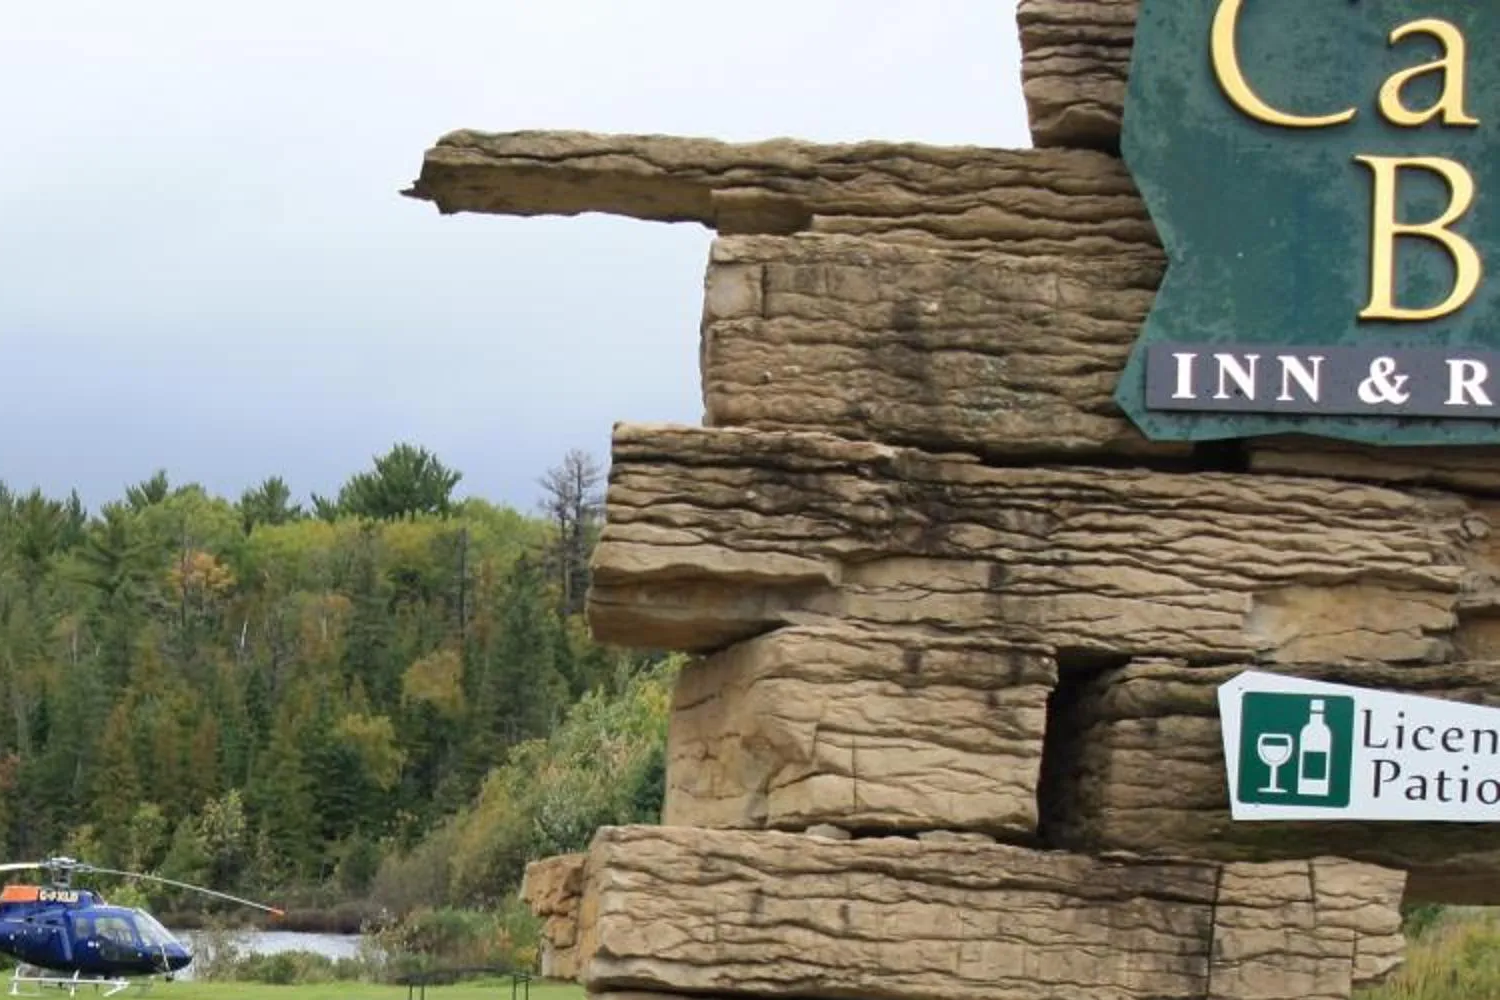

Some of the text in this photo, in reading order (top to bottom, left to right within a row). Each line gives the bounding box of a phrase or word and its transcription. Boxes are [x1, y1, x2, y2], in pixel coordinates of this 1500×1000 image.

[1209, 0, 1480, 128] Ca
[1352, 155, 1483, 322] B
[1171, 352, 1493, 406] INN & R
[1361, 709, 1500, 754] Licen
[1371, 759, 1500, 805] Patio
